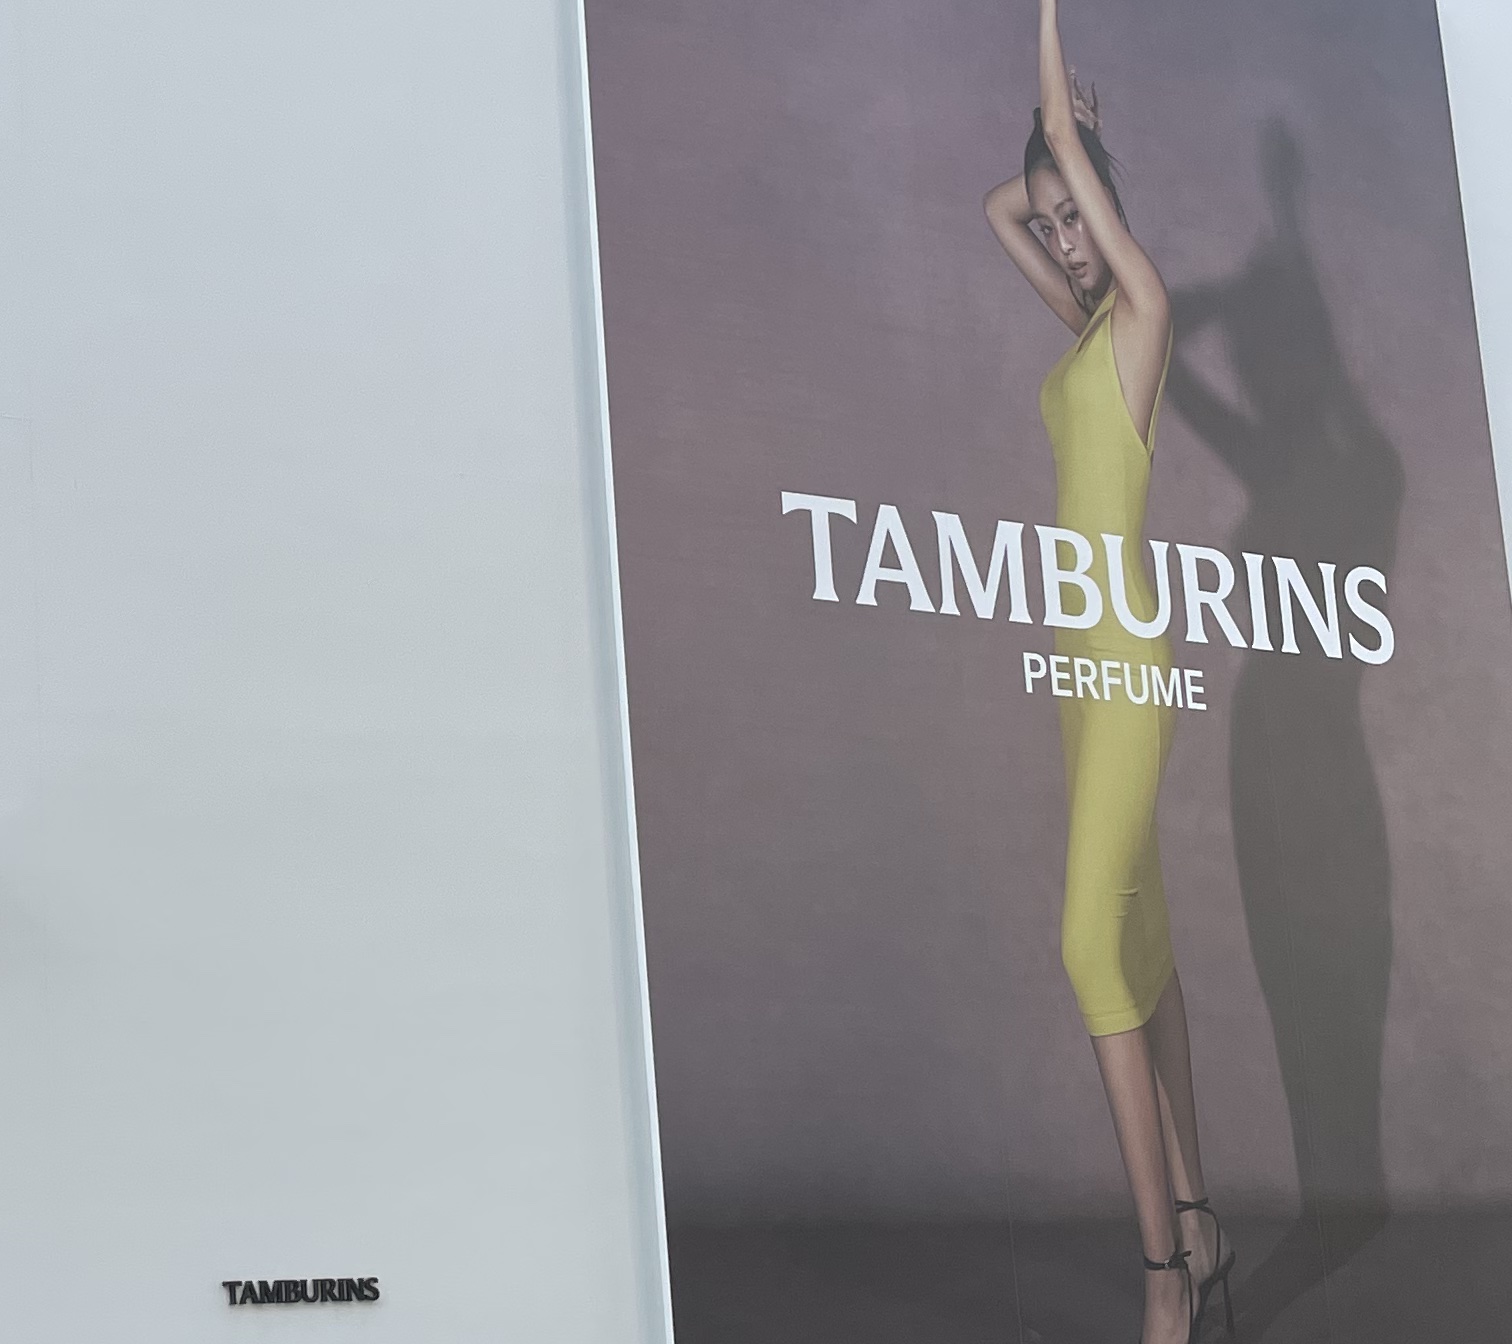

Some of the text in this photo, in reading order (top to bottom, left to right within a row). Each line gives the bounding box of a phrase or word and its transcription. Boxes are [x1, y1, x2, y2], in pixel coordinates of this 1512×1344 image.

[781, 490, 1395, 665] TAMBURINS
[1022, 652, 1207, 711] PERFUME
[221, 1277, 380, 1305] TAMBURINS
